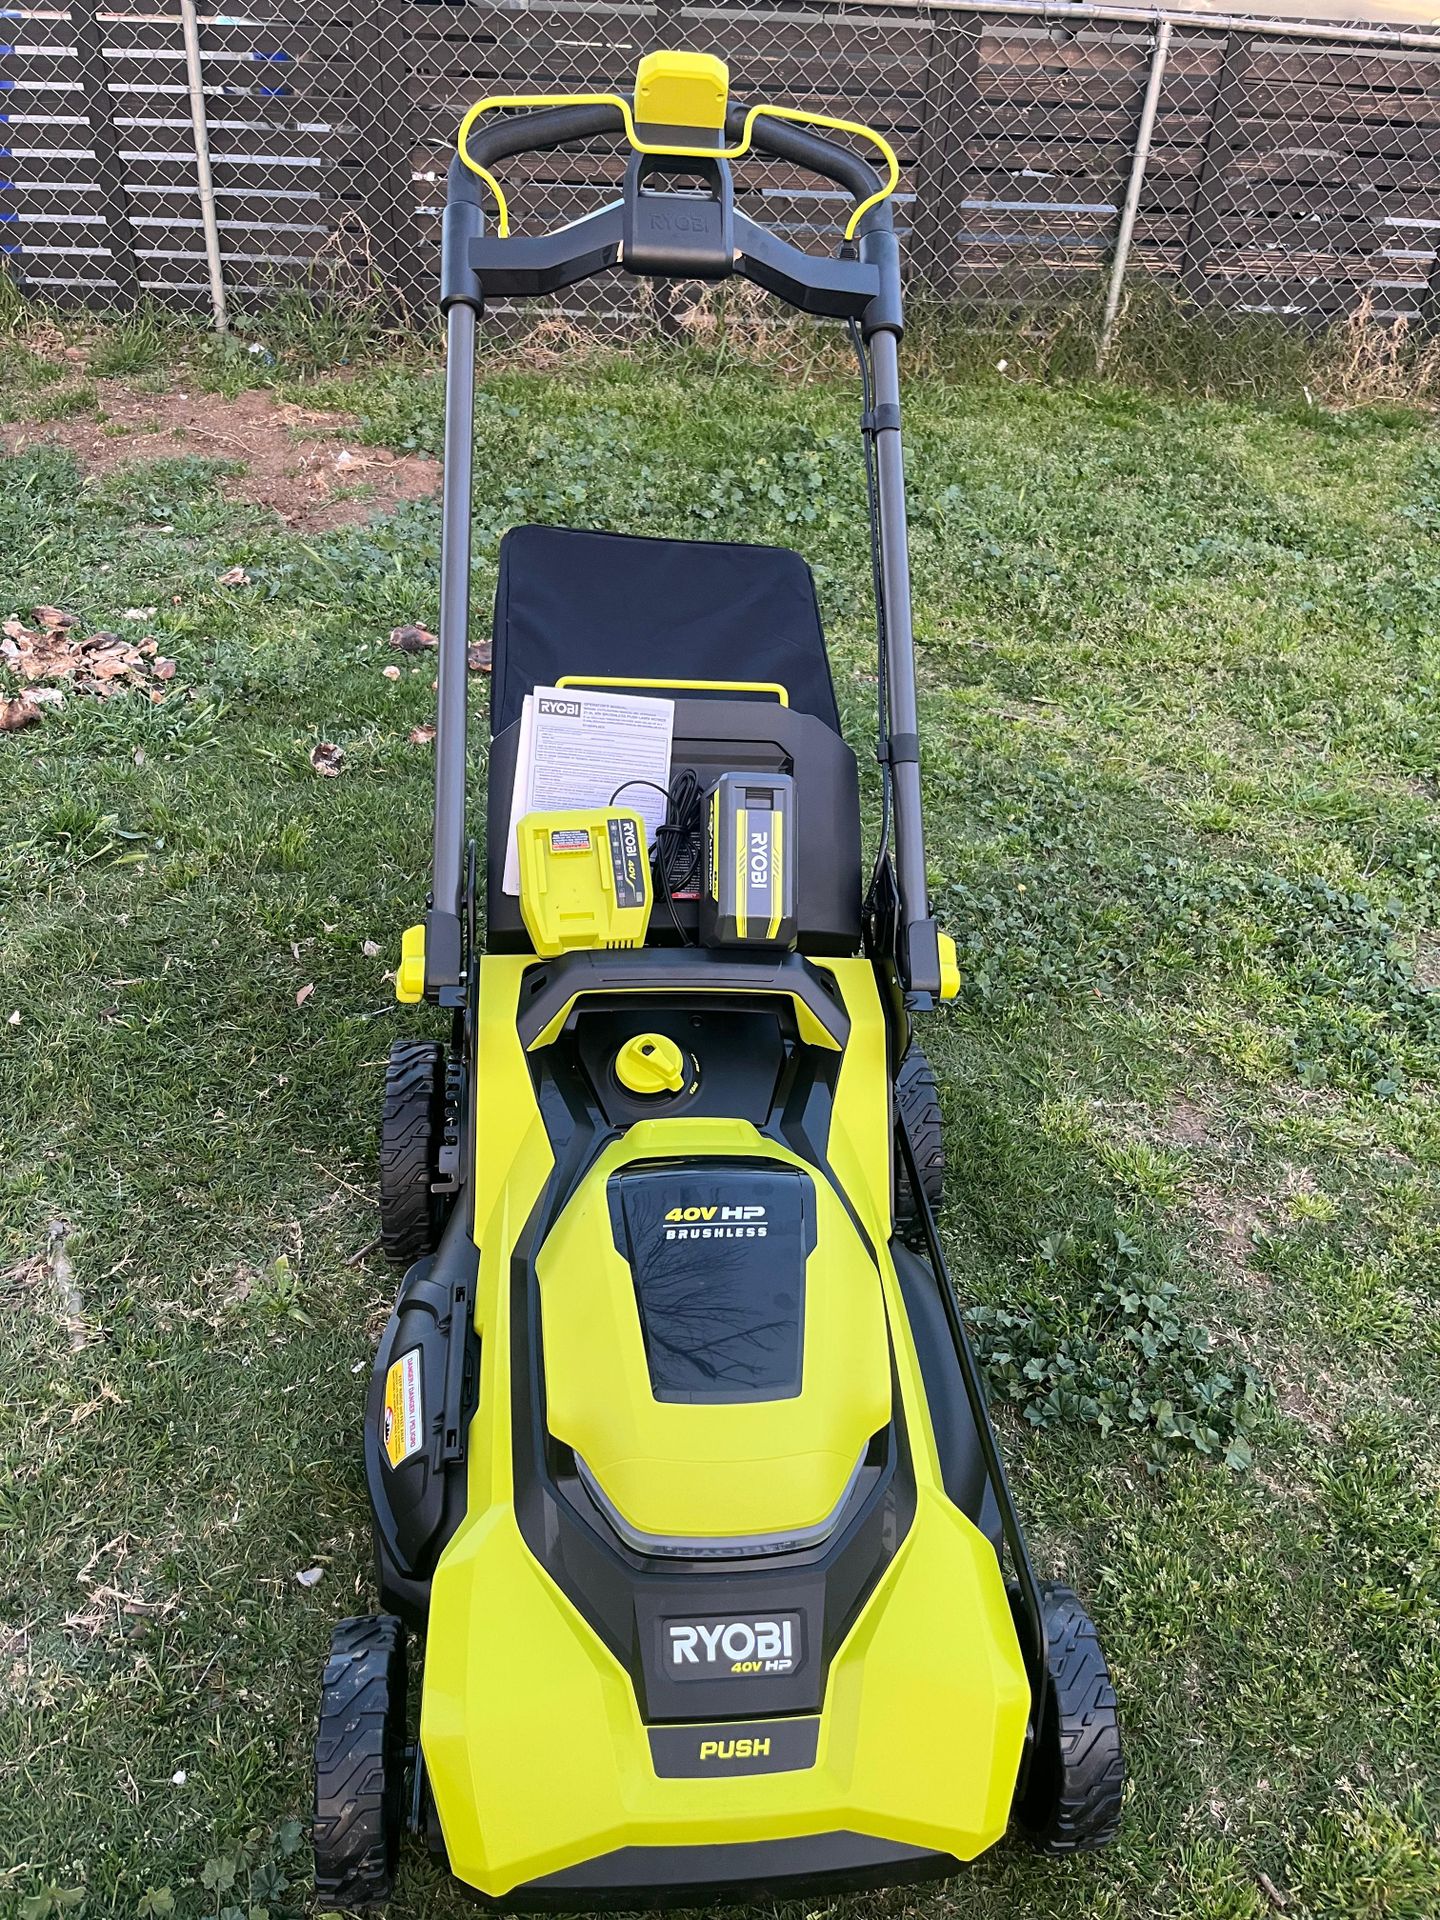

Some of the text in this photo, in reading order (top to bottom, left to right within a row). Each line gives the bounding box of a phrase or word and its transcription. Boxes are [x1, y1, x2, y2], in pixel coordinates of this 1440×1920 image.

[650, 213, 709, 233] RYOBI
[540, 700, 579, 715] RYOBI
[623, 822, 638, 881] RYOBI 40V
[751, 832, 769, 888] RYOBI
[664, 1206, 766, 1221] 40V HP
[666, 1227, 768, 1240] BRUSHLESS
[670, 1620, 792, 1664] RYOBI
[730, 1659, 793, 1673] 40V HP
[699, 1737, 771, 1760] PUSH
